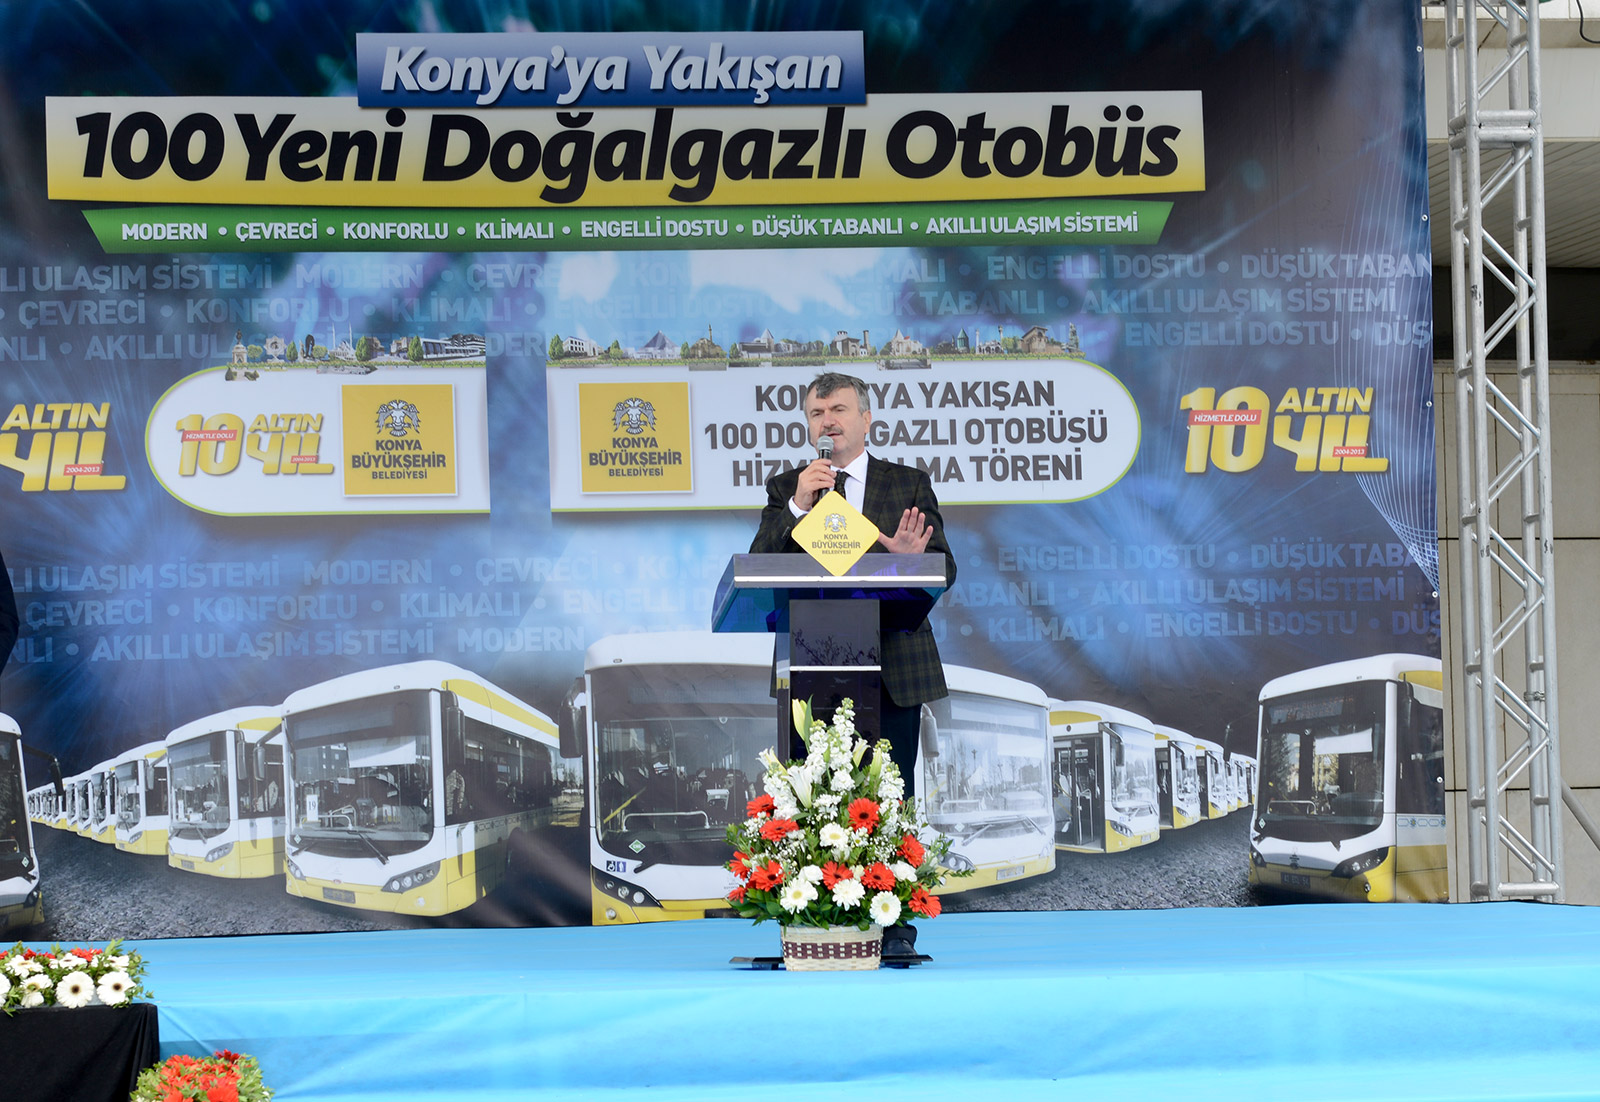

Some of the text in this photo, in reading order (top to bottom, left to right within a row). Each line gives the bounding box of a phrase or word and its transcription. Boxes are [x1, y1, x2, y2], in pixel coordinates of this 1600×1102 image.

[643, 43, 842, 105] Yakışan
[76, 104, 1181, 204] 100 Yeni Doğalgazlı Otobüs
[121, 211, 1138, 242] MODERN ÇEVRECİ KONFORLU KLİMALI ENGELLİ DOSTU DÜŞÜK TABANLI AKILLI ULAŞIM SİSTEMİ
[32, 264, 147, 294] ULAŞIM
[152, 257, 272, 290] SİSTEMİ
[296, 263, 423, 289] MODERN
[467, 264, 562, 291] ÇEVRE
[987, 248, 1106, 281] ENGELLİ
[1113, 254, 1205, 280] DOSTU
[1241, 247, 1338, 283] DÜŞÜK
[18, 293, 146, 330] ÇEVRECİ
[186, 298, 349, 324] KONFORLU
[392, 291, 512, 322] KLİMALI
[919, 289, 1046, 316] TABANLI
[1080, 288, 1172, 314] AKILLI
[1177, 287, 1283, 320] ULAŞIM
[1287, 281, 1397, 313] SİSTEMİ
[84, 334, 182, 361] AKILLI
[1125, 315, 1242, 347] ENGELLİ
[1250, 320, 1339, 346] DOSTU
[917, 380, 1055, 412] YAKIŞAN
[1275, 387, 1374, 413] ALTIN
[1, 402, 110, 431] ALTIN
[248, 413, 323, 432] ALTIN
[704, 423, 757, 450] 100
[964, 409, 1108, 445] OTOBÜSÜ
[1180, 386, 1271, 473] 10
[1194, 412, 1257, 422] HİZMETLE DOLU
[176, 413, 245, 476] 10
[375, 440, 423, 452] KONYA
[588, 448, 683, 467] BÜYÜKŞEHİR
[612, 437, 659, 449] KONYA
[351, 451, 447, 470] BÜYÜKŞEHİR
[371, 469, 428, 480] BELEDİYESİ
[608, 466, 664, 478] BELEDİYESİ
[970, 447, 1082, 483] TÖRENİ
[811, 540, 861, 550] BÜYÜKŞEHİR
[38, 564, 154, 594] ULAŞIM
[158, 555, 279, 588] SİSTEMİ
[303, 559, 433, 586] MODERN
[998, 538, 1117, 571] ENGELLİ
[1123, 543, 1216, 570] DOSTU
[1251, 537, 1345, 571] DÜŞÜK
[25, 592, 152, 631] ÇEVRECİ
[193, 594, 358, 623] KONFORLU
[400, 586, 521, 618] KLİMALI
[1090, 578, 1182, 605] AKILLI
[1187, 577, 1291, 607] ULAŞIM
[1296, 570, 1405, 602] SİSTEMİ
[91, 633, 189, 662] AKILLI
[194, 630, 309, 661] ULAŞIM
[314, 622, 434, 657] SİSTEMİ
[457, 626, 585, 653] MODERN
[988, 611, 1104, 642] KLİMALI
[1145, 605, 1262, 637] ENGELLİ
[1268, 611, 1357, 636] DOSTU
